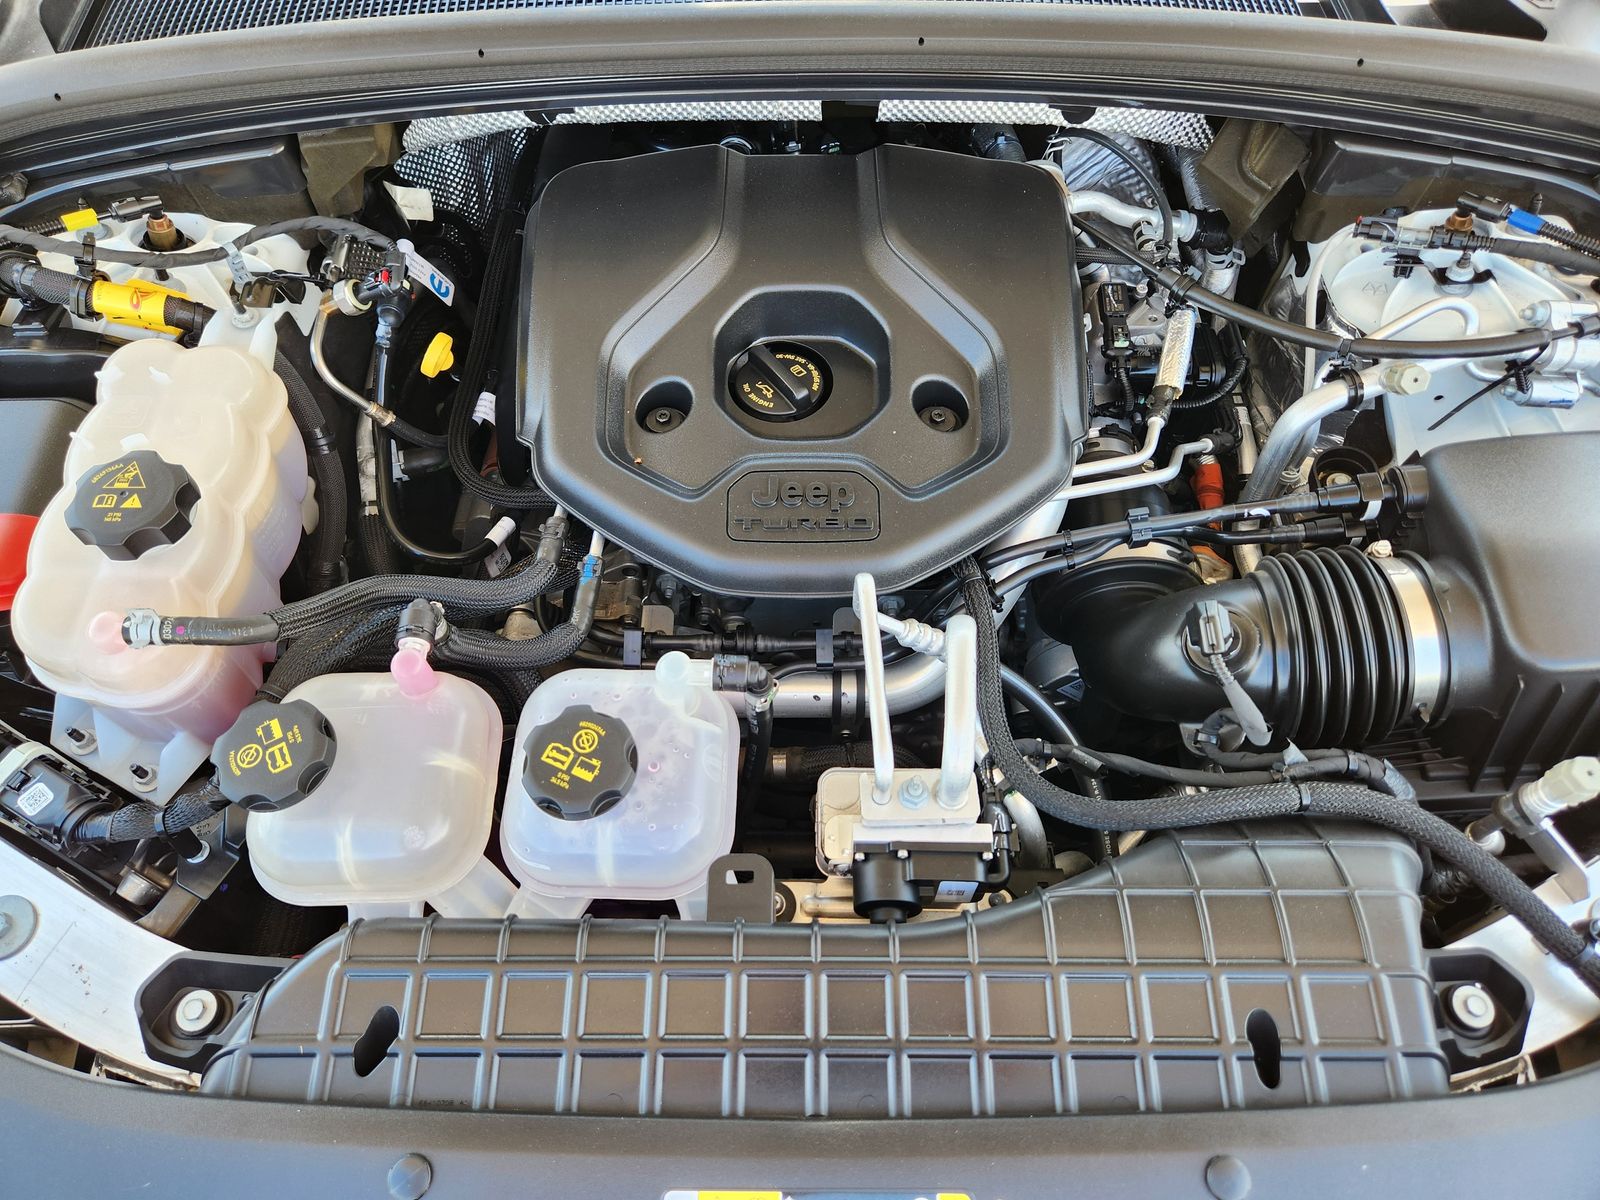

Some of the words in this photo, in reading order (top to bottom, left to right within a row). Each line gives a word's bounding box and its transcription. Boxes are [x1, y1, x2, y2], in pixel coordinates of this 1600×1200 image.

[742, 383, 751, 393] OIL
[748, 392, 774, 408] ENGINE
[751, 474, 855, 513] Jeep
[734, 517, 874, 531] TURBO
